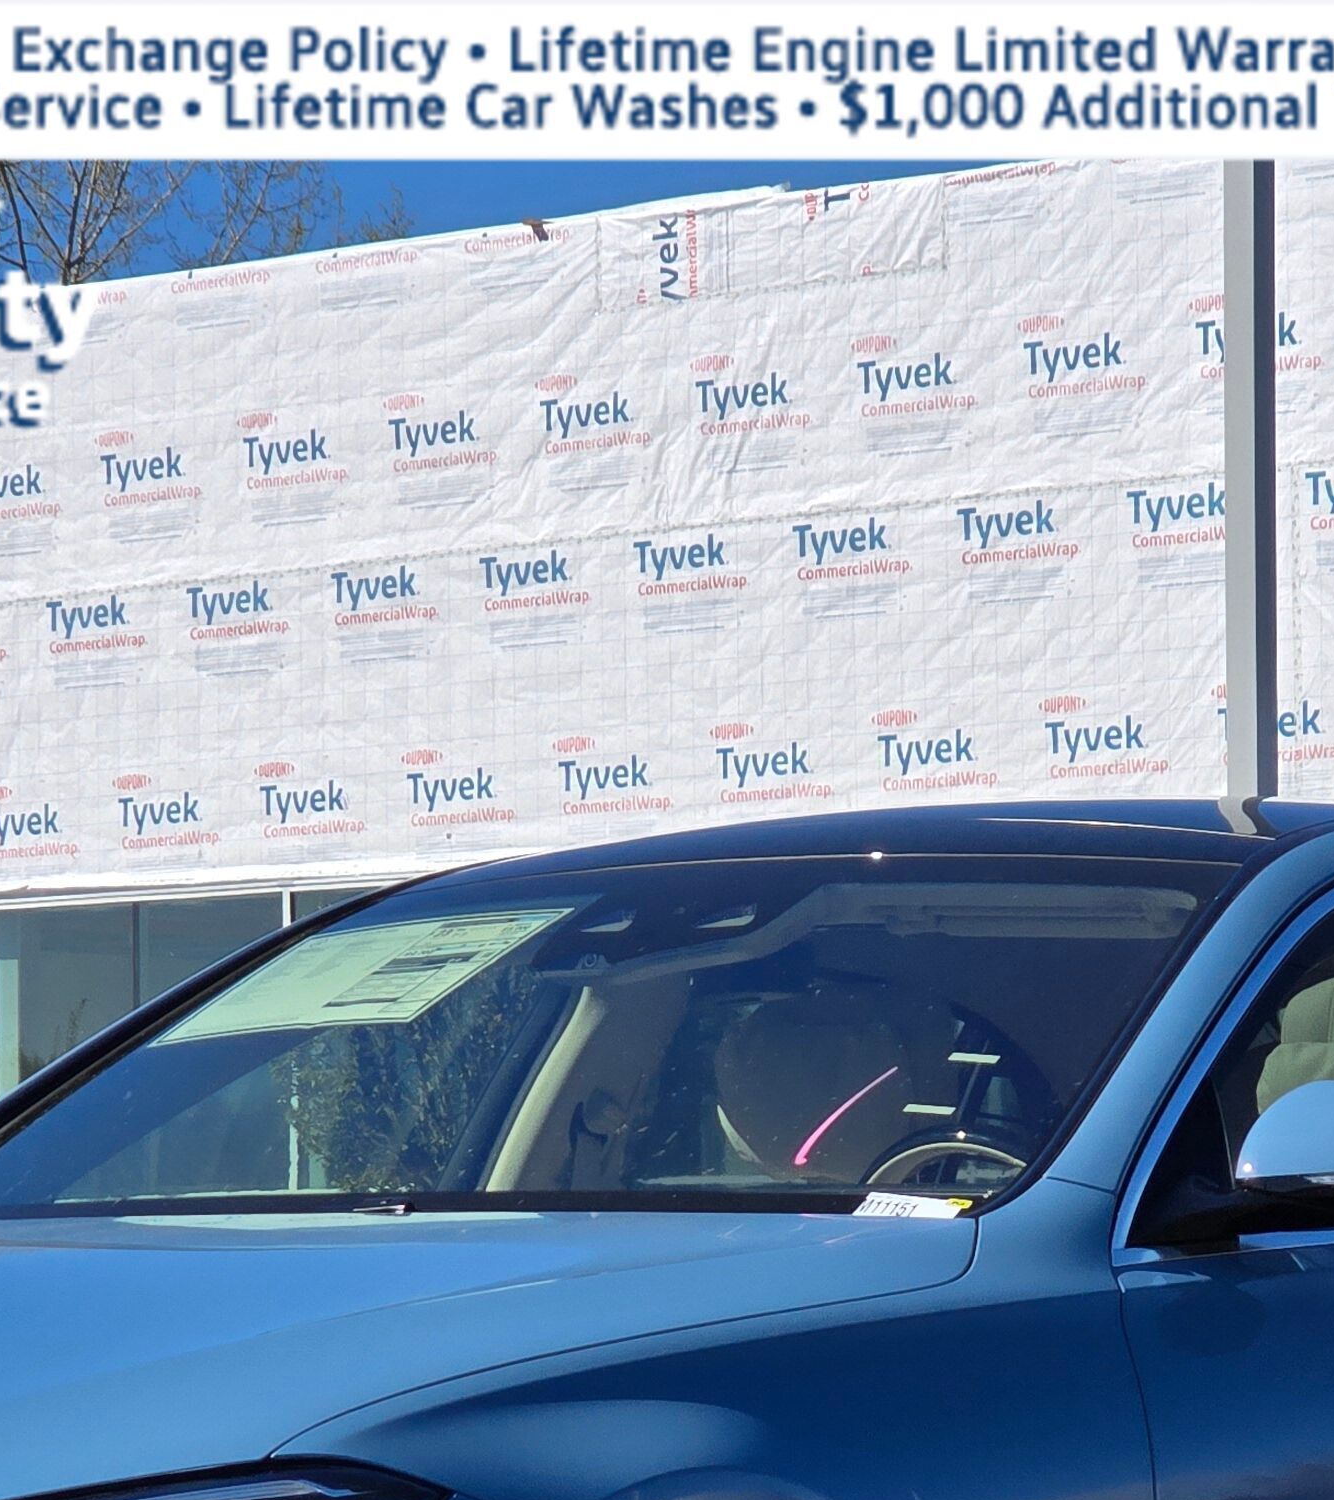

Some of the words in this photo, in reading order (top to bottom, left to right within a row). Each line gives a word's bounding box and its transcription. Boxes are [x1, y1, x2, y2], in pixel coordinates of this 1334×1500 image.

[860, 355, 952, 401] Tyvek
[1025, 335, 1123, 382] Tyvek
[542, 393, 631, 438] Tyvek
[696, 376, 789, 420] Tyvek
[245, 432, 328, 474] Tyvek
[390, 412, 476, 456] Tyvek
[104, 449, 183, 491] Tyvek
[104, 449, 183, 491] Tyvek
[796, 520, 888, 565] Tyvek
[958, 502, 1055, 548] Tyvek
[482, 553, 568, 596] Tyvek
[637, 537, 725, 580] Tyvek
[799, 560, 911, 581] CommercialWrap
[961, 544, 1079, 565] CommercialWrap
[190, 582, 269, 624] Tyvek
[334, 568, 417, 611] Tyvek
[485, 591, 591, 613] CommercialWrap
[637, 576, 747, 598] CommercialWrap
[48, 597, 128, 639] Tyvek
[192, 621, 288, 640] CommercialWrap
[337, 607, 438, 626] CommercialWrap
[51, 635, 146, 655] CommercialWrap
[882, 731, 974, 774] Tyvek
[1047, 716, 1144, 763] Tyvek
[560, 755, 648, 797] Tyvek
[717, 744, 811, 786] Tyvek
[263, 783, 345, 823] Tyvek
[409, 768, 494, 811] Tyvek
[121, 794, 201, 833] Tyvek
